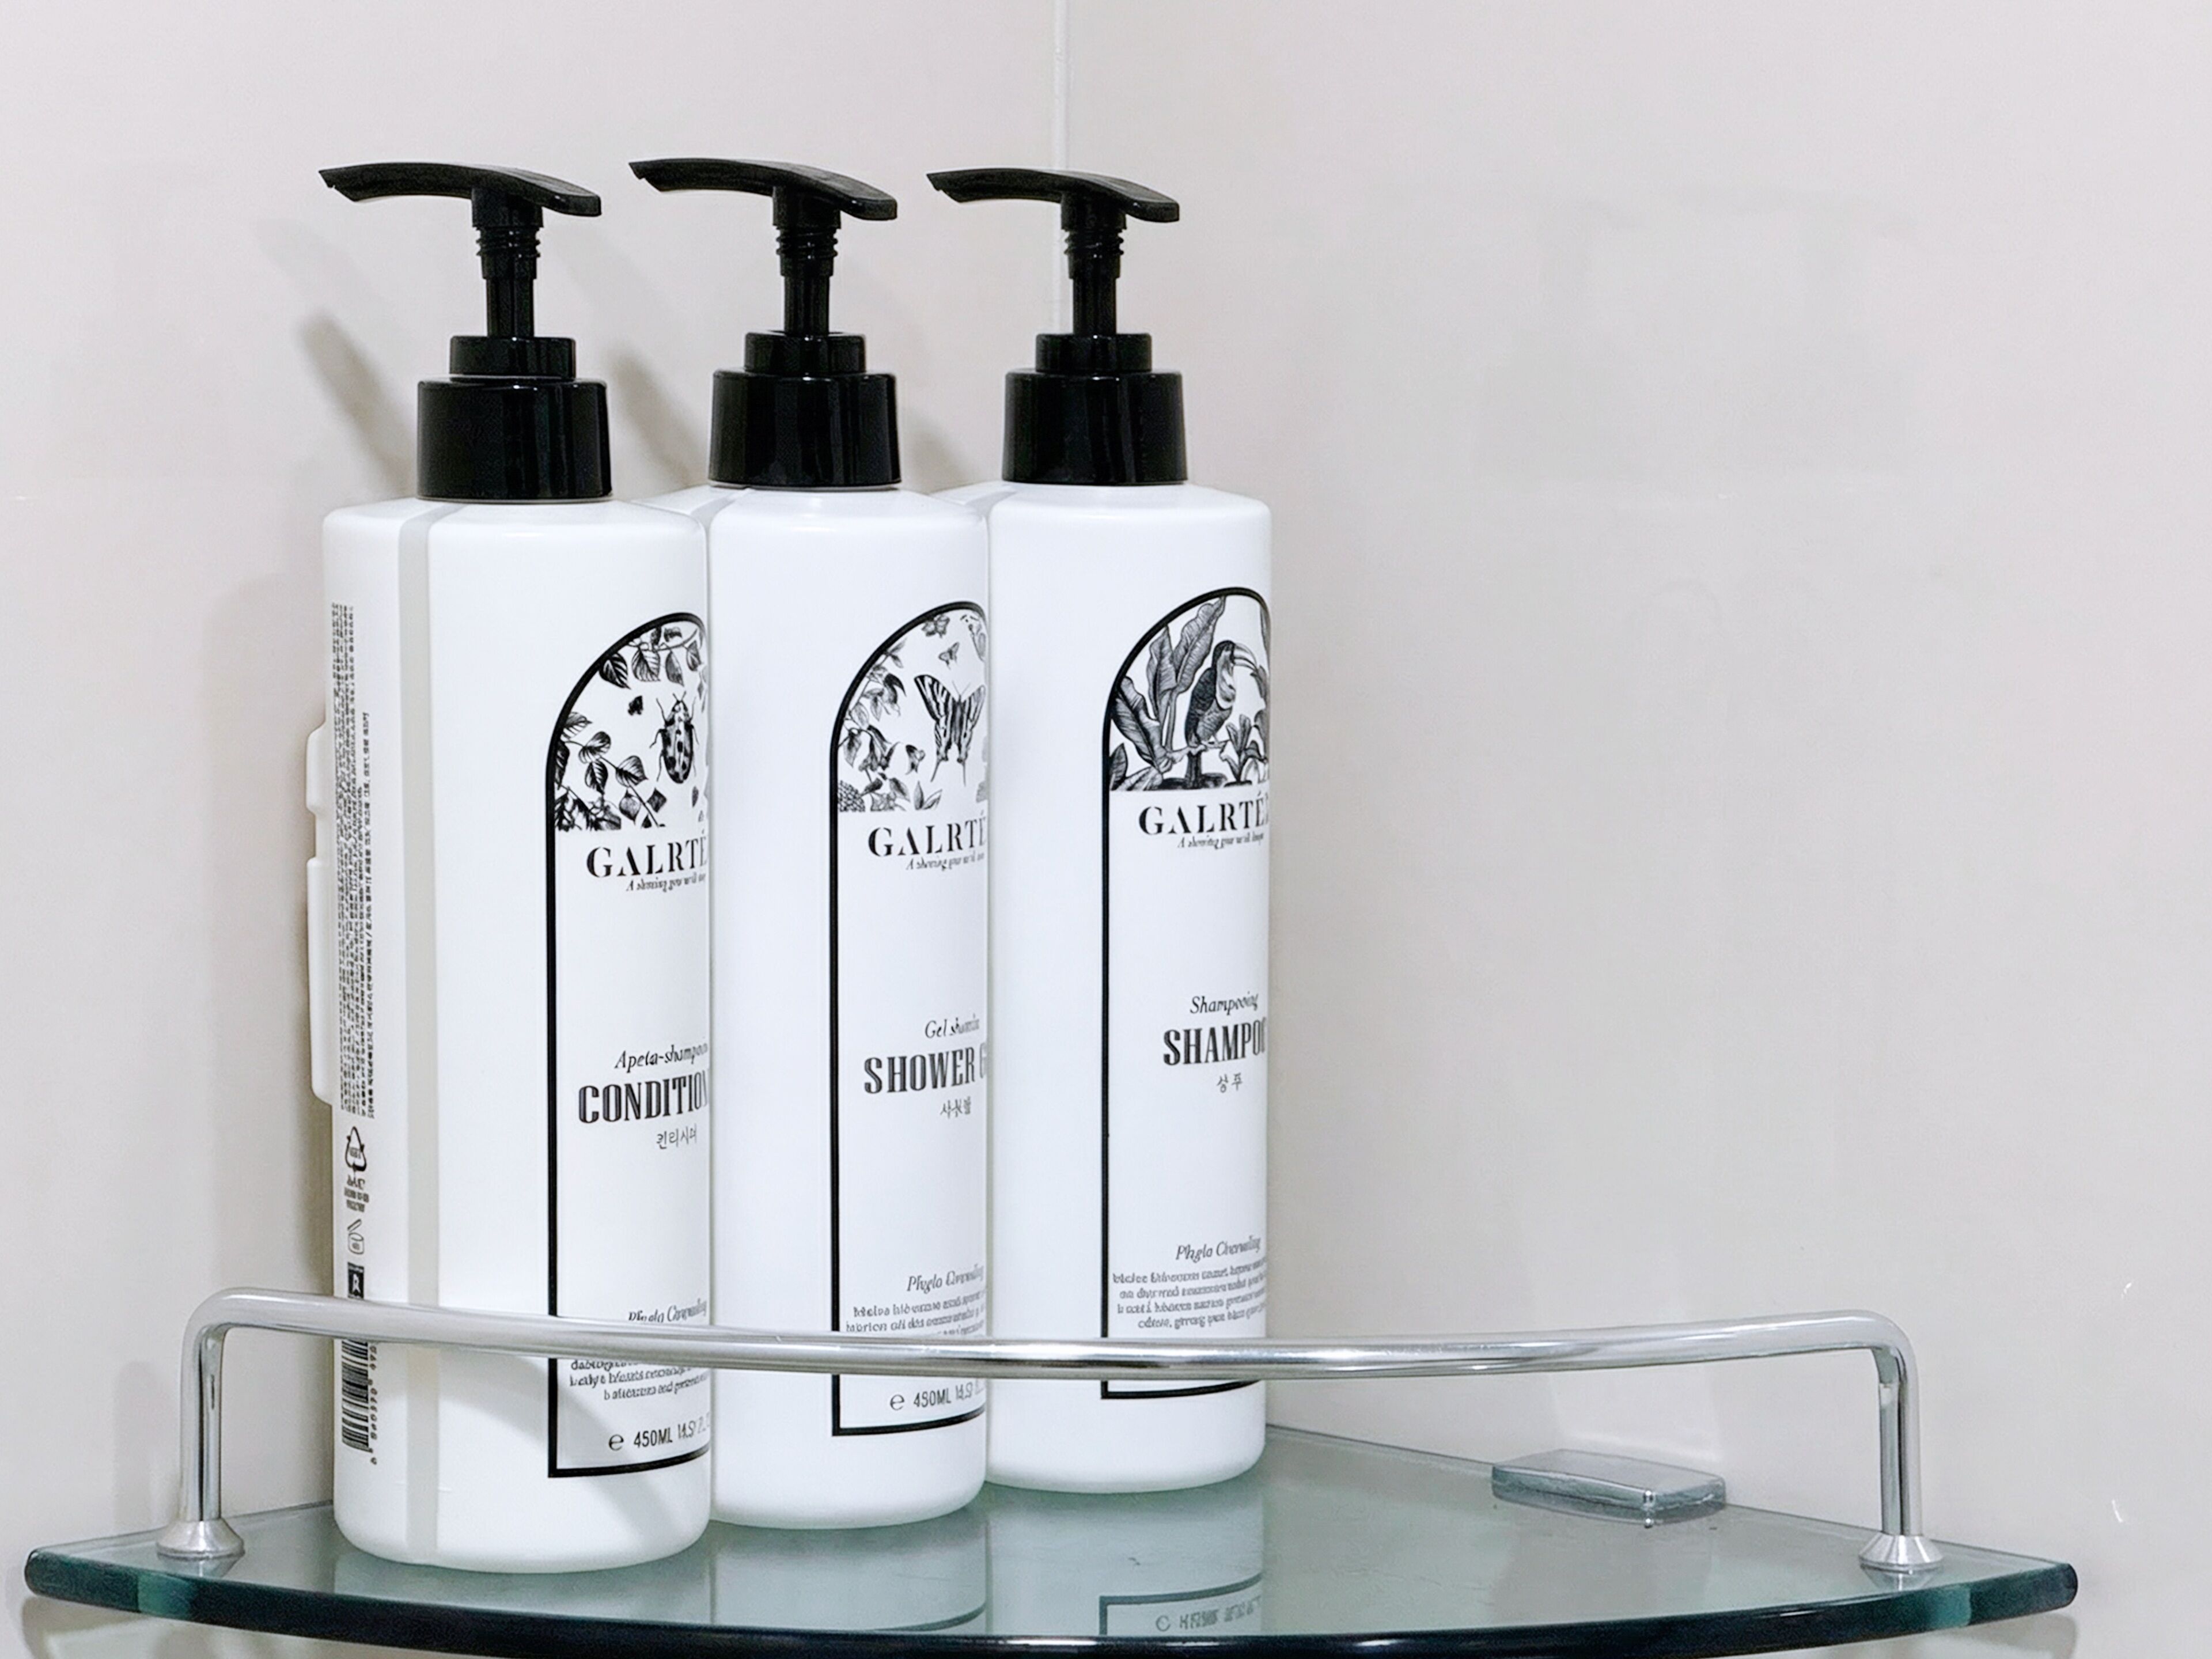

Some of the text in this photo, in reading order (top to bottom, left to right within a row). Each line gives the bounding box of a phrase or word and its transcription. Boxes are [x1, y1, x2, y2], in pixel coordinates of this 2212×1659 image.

[925, 1018, 947, 1039] Gel
[864, 1047, 975, 1094] SHOWER
[634, 1427, 673, 1448] 450ML
